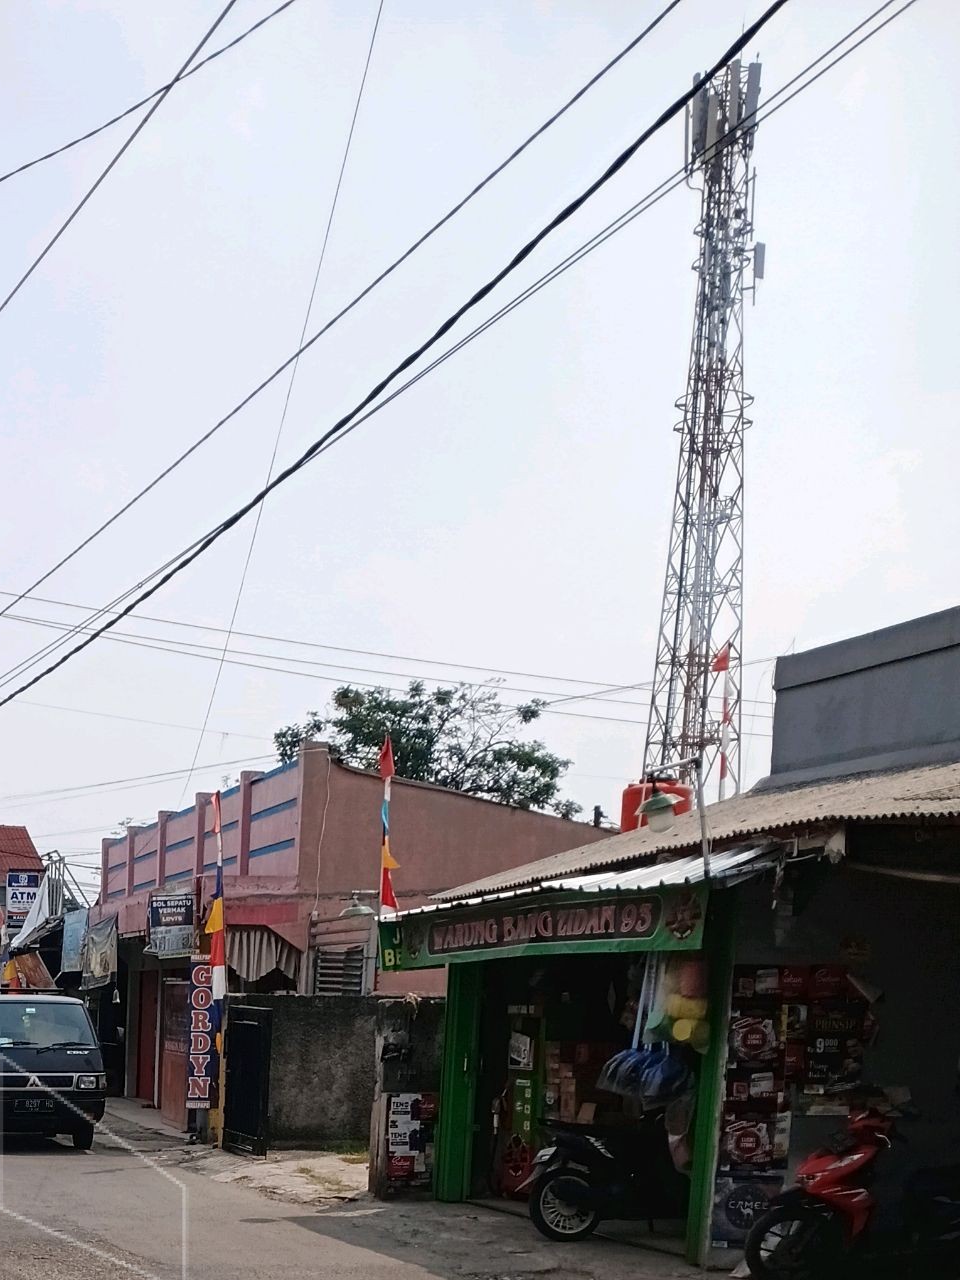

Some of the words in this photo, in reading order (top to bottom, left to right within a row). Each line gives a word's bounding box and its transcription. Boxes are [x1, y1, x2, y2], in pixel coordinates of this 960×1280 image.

[11, 891, 37, 901] ATM
[167, 899, 192, 907] SEPATU
[434, 919, 498, 950] WARUNG
[503, 911, 553, 941] BANG
[557, 906, 617, 937] ZIDAN
[188, 965, 213, 1098] GORDYN
[727, 1200, 769, 1210] CAMEL
